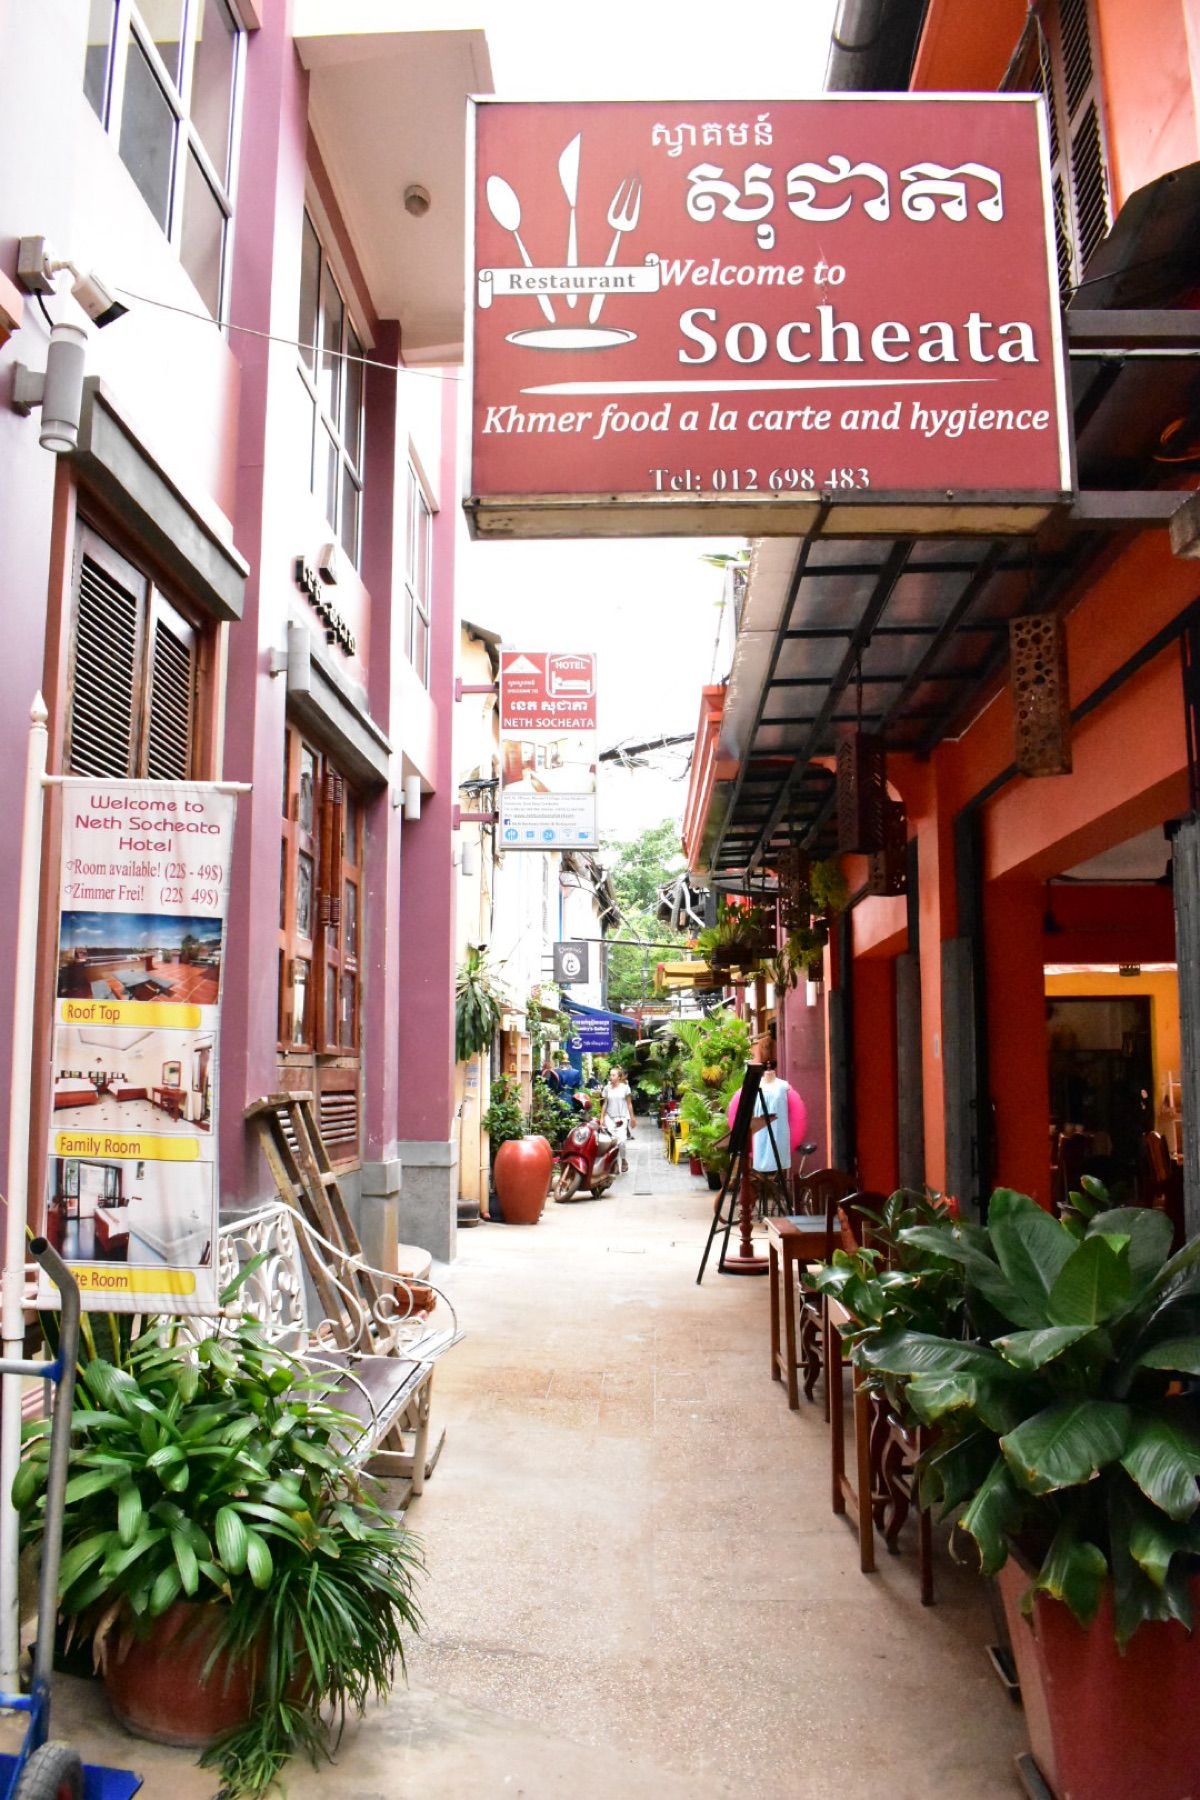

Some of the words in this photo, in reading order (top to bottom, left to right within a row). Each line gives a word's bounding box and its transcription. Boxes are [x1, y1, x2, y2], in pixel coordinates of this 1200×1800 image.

[652, 112, 773, 157] ស្វាគមន៍
[686, 154, 1004, 250] សុជាតា
[508, 273, 637, 290] Restaurant
[660, 258, 804, 287] Welcome
[813, 259, 846, 286] to
[678, 305, 1040, 364] Socheata
[482, 406, 594, 434] Khmer
[592, 402, 670, 440] food
[679, 411, 700, 432] a
[708, 404, 739, 432] la
[747, 406, 832, 432] carte
[840, 402, 901, 431] and
[910, 401, 1050, 438] hygience
[648, 468, 702, 491] Tel:
[711, 467, 759, 491] 012
[768, 467, 816, 490] 698
[823, 467, 871, 490] 483
[555, 660, 587, 670] HOTEL
[503, 717, 533, 728] NETH
[536, 717, 594, 728] SOCHEATA
[90, 795, 178, 812] Welcome
[184, 800, 205, 813] to
[74, 814, 122, 830] Neth
[128, 816, 221, 835] Socheata
[119, 836, 172, 852] Hotel
[73, 858, 107, 877] Room
[109, 861, 161, 878] available!
[72, 882, 116, 900] Zimmer
[118, 884, 145, 902] Frei!
[67, 1004, 96, 1019] Roof
[99, 1005, 120, 1023] Top
[60, 1136, 101, 1155] Family
[104, 1138, 141, 1154] Room
[91, 1272, 128, 1287] Room
